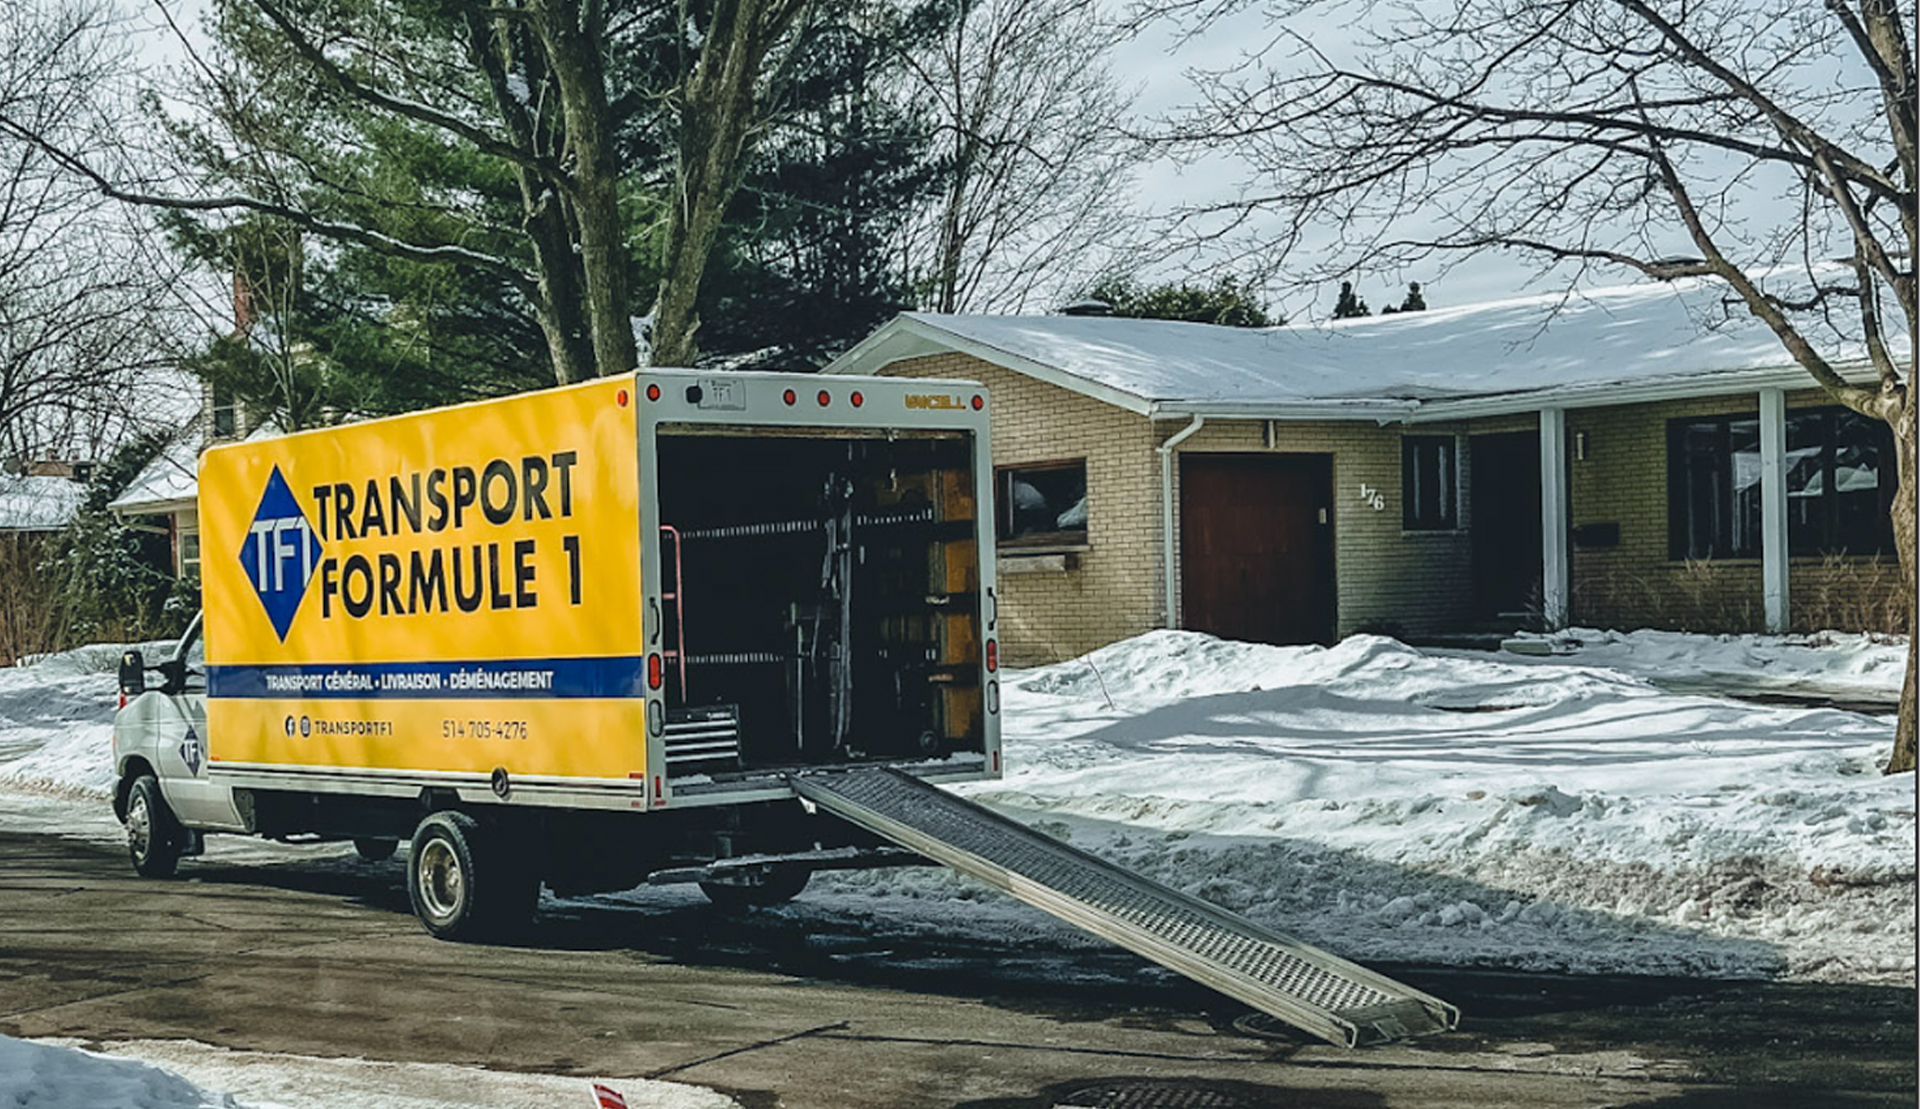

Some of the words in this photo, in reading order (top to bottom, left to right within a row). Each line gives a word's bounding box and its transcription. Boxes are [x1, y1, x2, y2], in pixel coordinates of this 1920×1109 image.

[313, 451, 577, 542] TRANSPORT
[1360, 483, 1384, 511] 176
[250, 516, 312, 592] TF1
[321, 539, 537, 619] FORMULE
[563, 535, 582, 605] 1
[266, 674, 323, 691] TRANSPORT
[324, 670, 374, 691] GÉNÉRAL
[381, 672, 441, 690] LIVRAISON
[450, 667, 554, 690] DÉMÉNAGEMENT
[315, 720, 393, 736] TRANSPORTF1
[443, 720, 465, 738] 514
[468, 720, 528, 740] 705-4276
